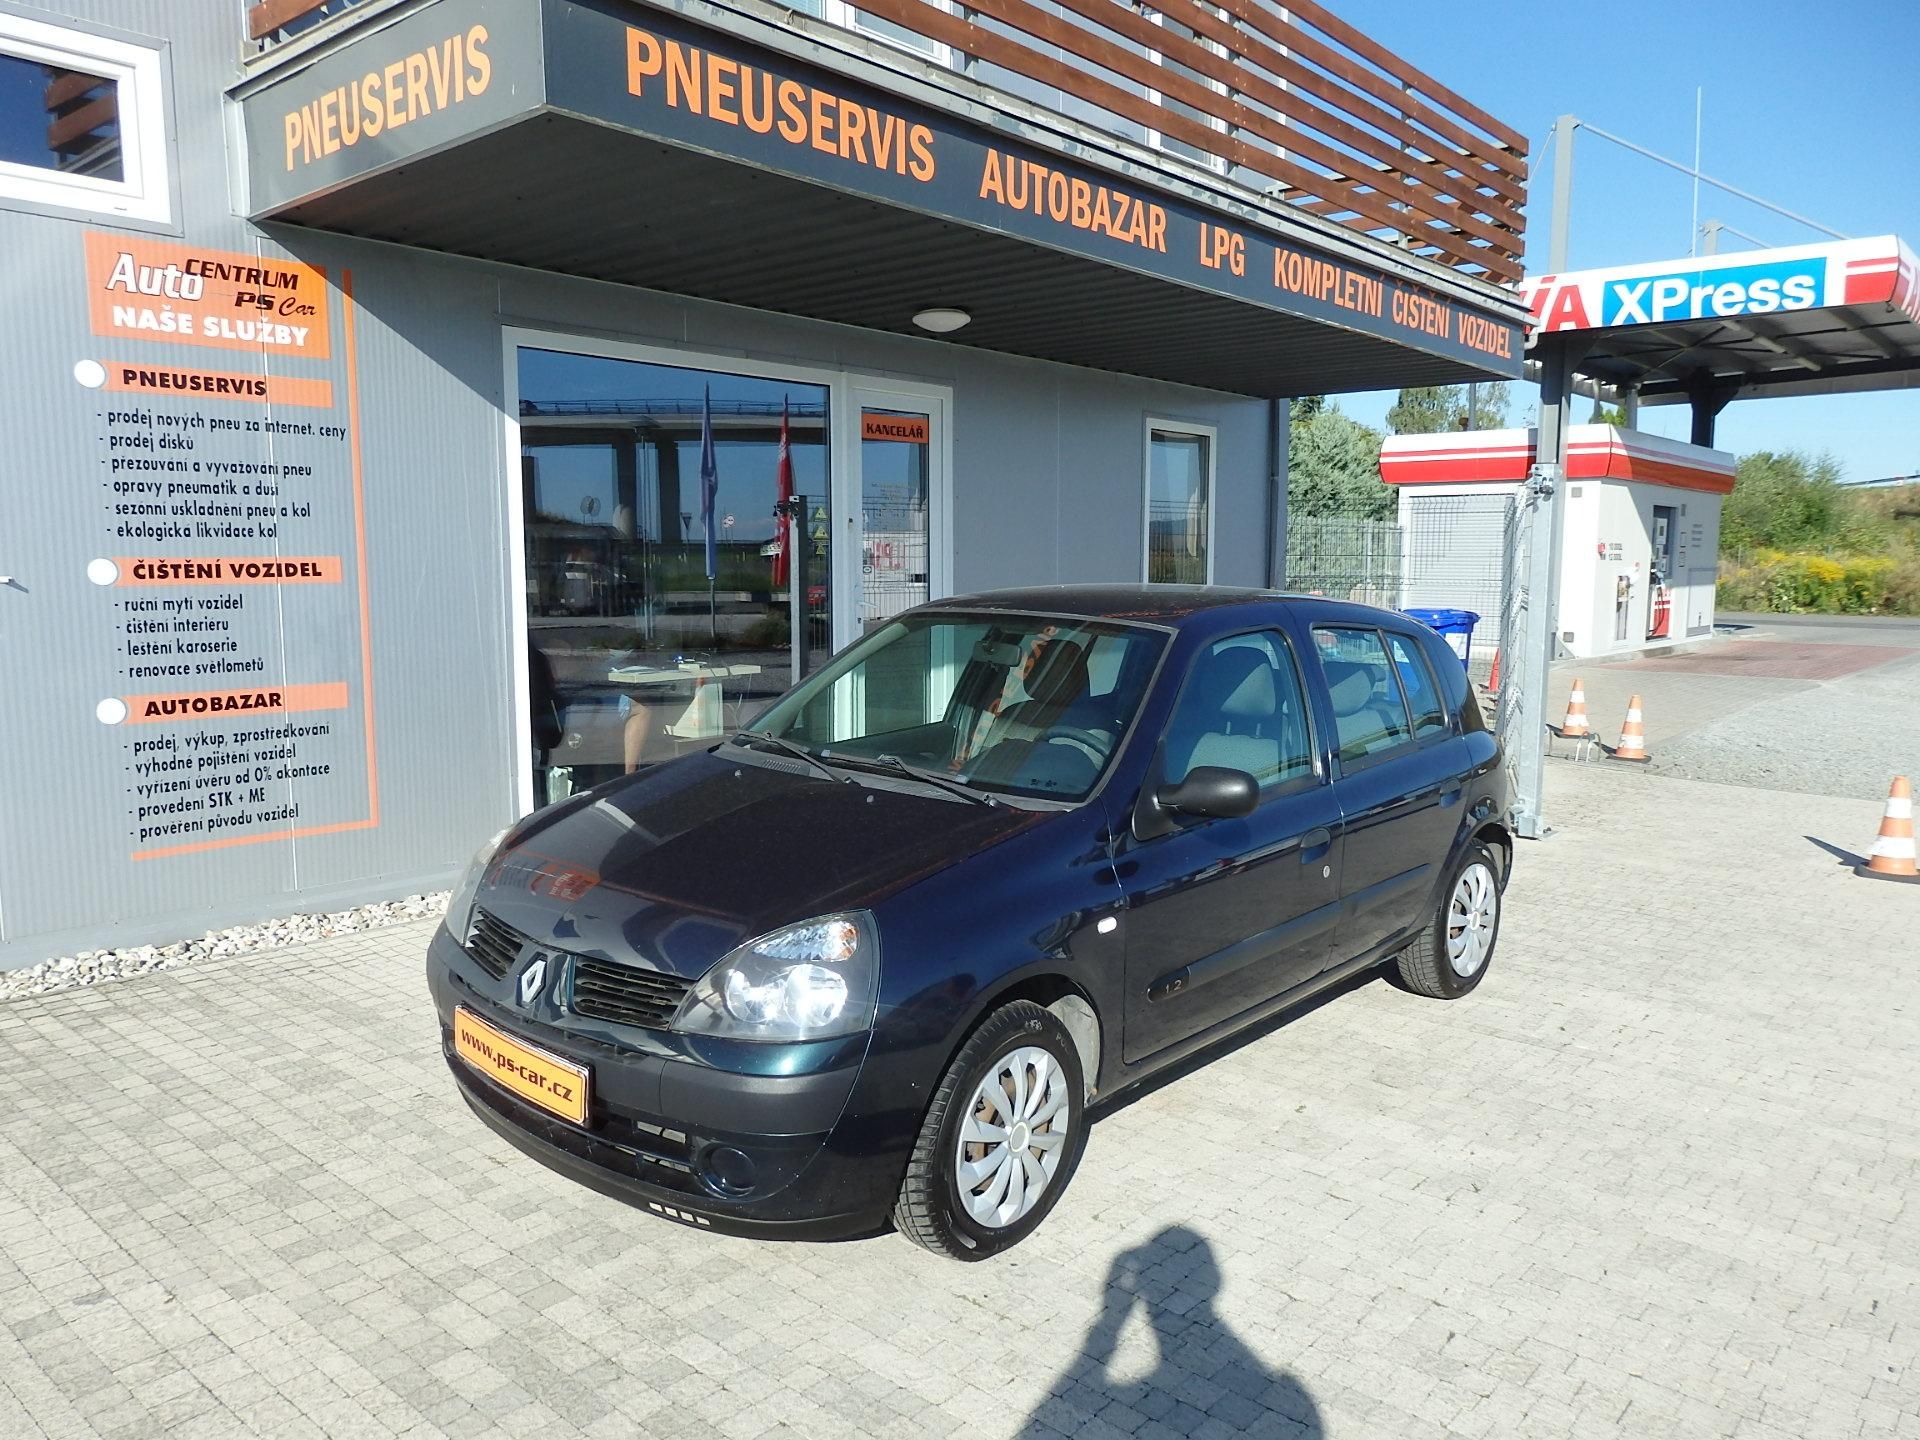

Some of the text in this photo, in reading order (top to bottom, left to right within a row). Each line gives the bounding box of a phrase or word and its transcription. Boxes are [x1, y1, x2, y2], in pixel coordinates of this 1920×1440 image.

[285, 24, 491, 172] PNEUSERVIS
[626, 27, 935, 182] PNEUSERVIS
[979, 148, 1167, 253] AUTOBAZAR
[1200, 225, 1245, 277] LPG
[1459, 312, 1512, 360] VOZIDEL
[105, 252, 204, 301] Auto
[185, 258, 298, 290] CENTRUM
[234, 291, 317, 316] PS Car
[1610, 271, 1816, 327] XPress
[112, 304, 309, 346] NAŠE SLUŽBY
[123, 369, 267, 396] PNEUSERVIS
[108, 408, 346, 441] prodej nových pneu za internet. ceny
[110, 432, 154, 452] prodej
[193, 462, 200, 472] a
[283, 462, 312, 478] pneu
[114, 481, 162, 498] opravy
[168, 480, 237, 497] pneumatik
[242, 485, 250, 495] a
[246, 504, 276, 520] pneu
[280, 507, 288, 517] a
[292, 502, 311, 517] kol
[196, 522, 254, 538] likvidace
[258, 522, 277, 538] kol
[133, 558, 322, 580] ČIŠTĚNÍ VOZIDEL
[198, 594, 244, 610] vozidel
[177, 637, 238, 654] karoserie
[129, 664, 190, 678] renovace
[144, 692, 282, 716] AUTOBAZAR
[254, 743, 296, 761] vozidel
[236, 769, 250, 784] od
[254, 766, 272, 782] 0%
[276, 764, 330, 779] akontace
[209, 790, 233, 808] STK
[248, 787, 266, 803] ME
[257, 803, 299, 822] vozidel
[462, 1029, 573, 1102] www.ps-car.cz
